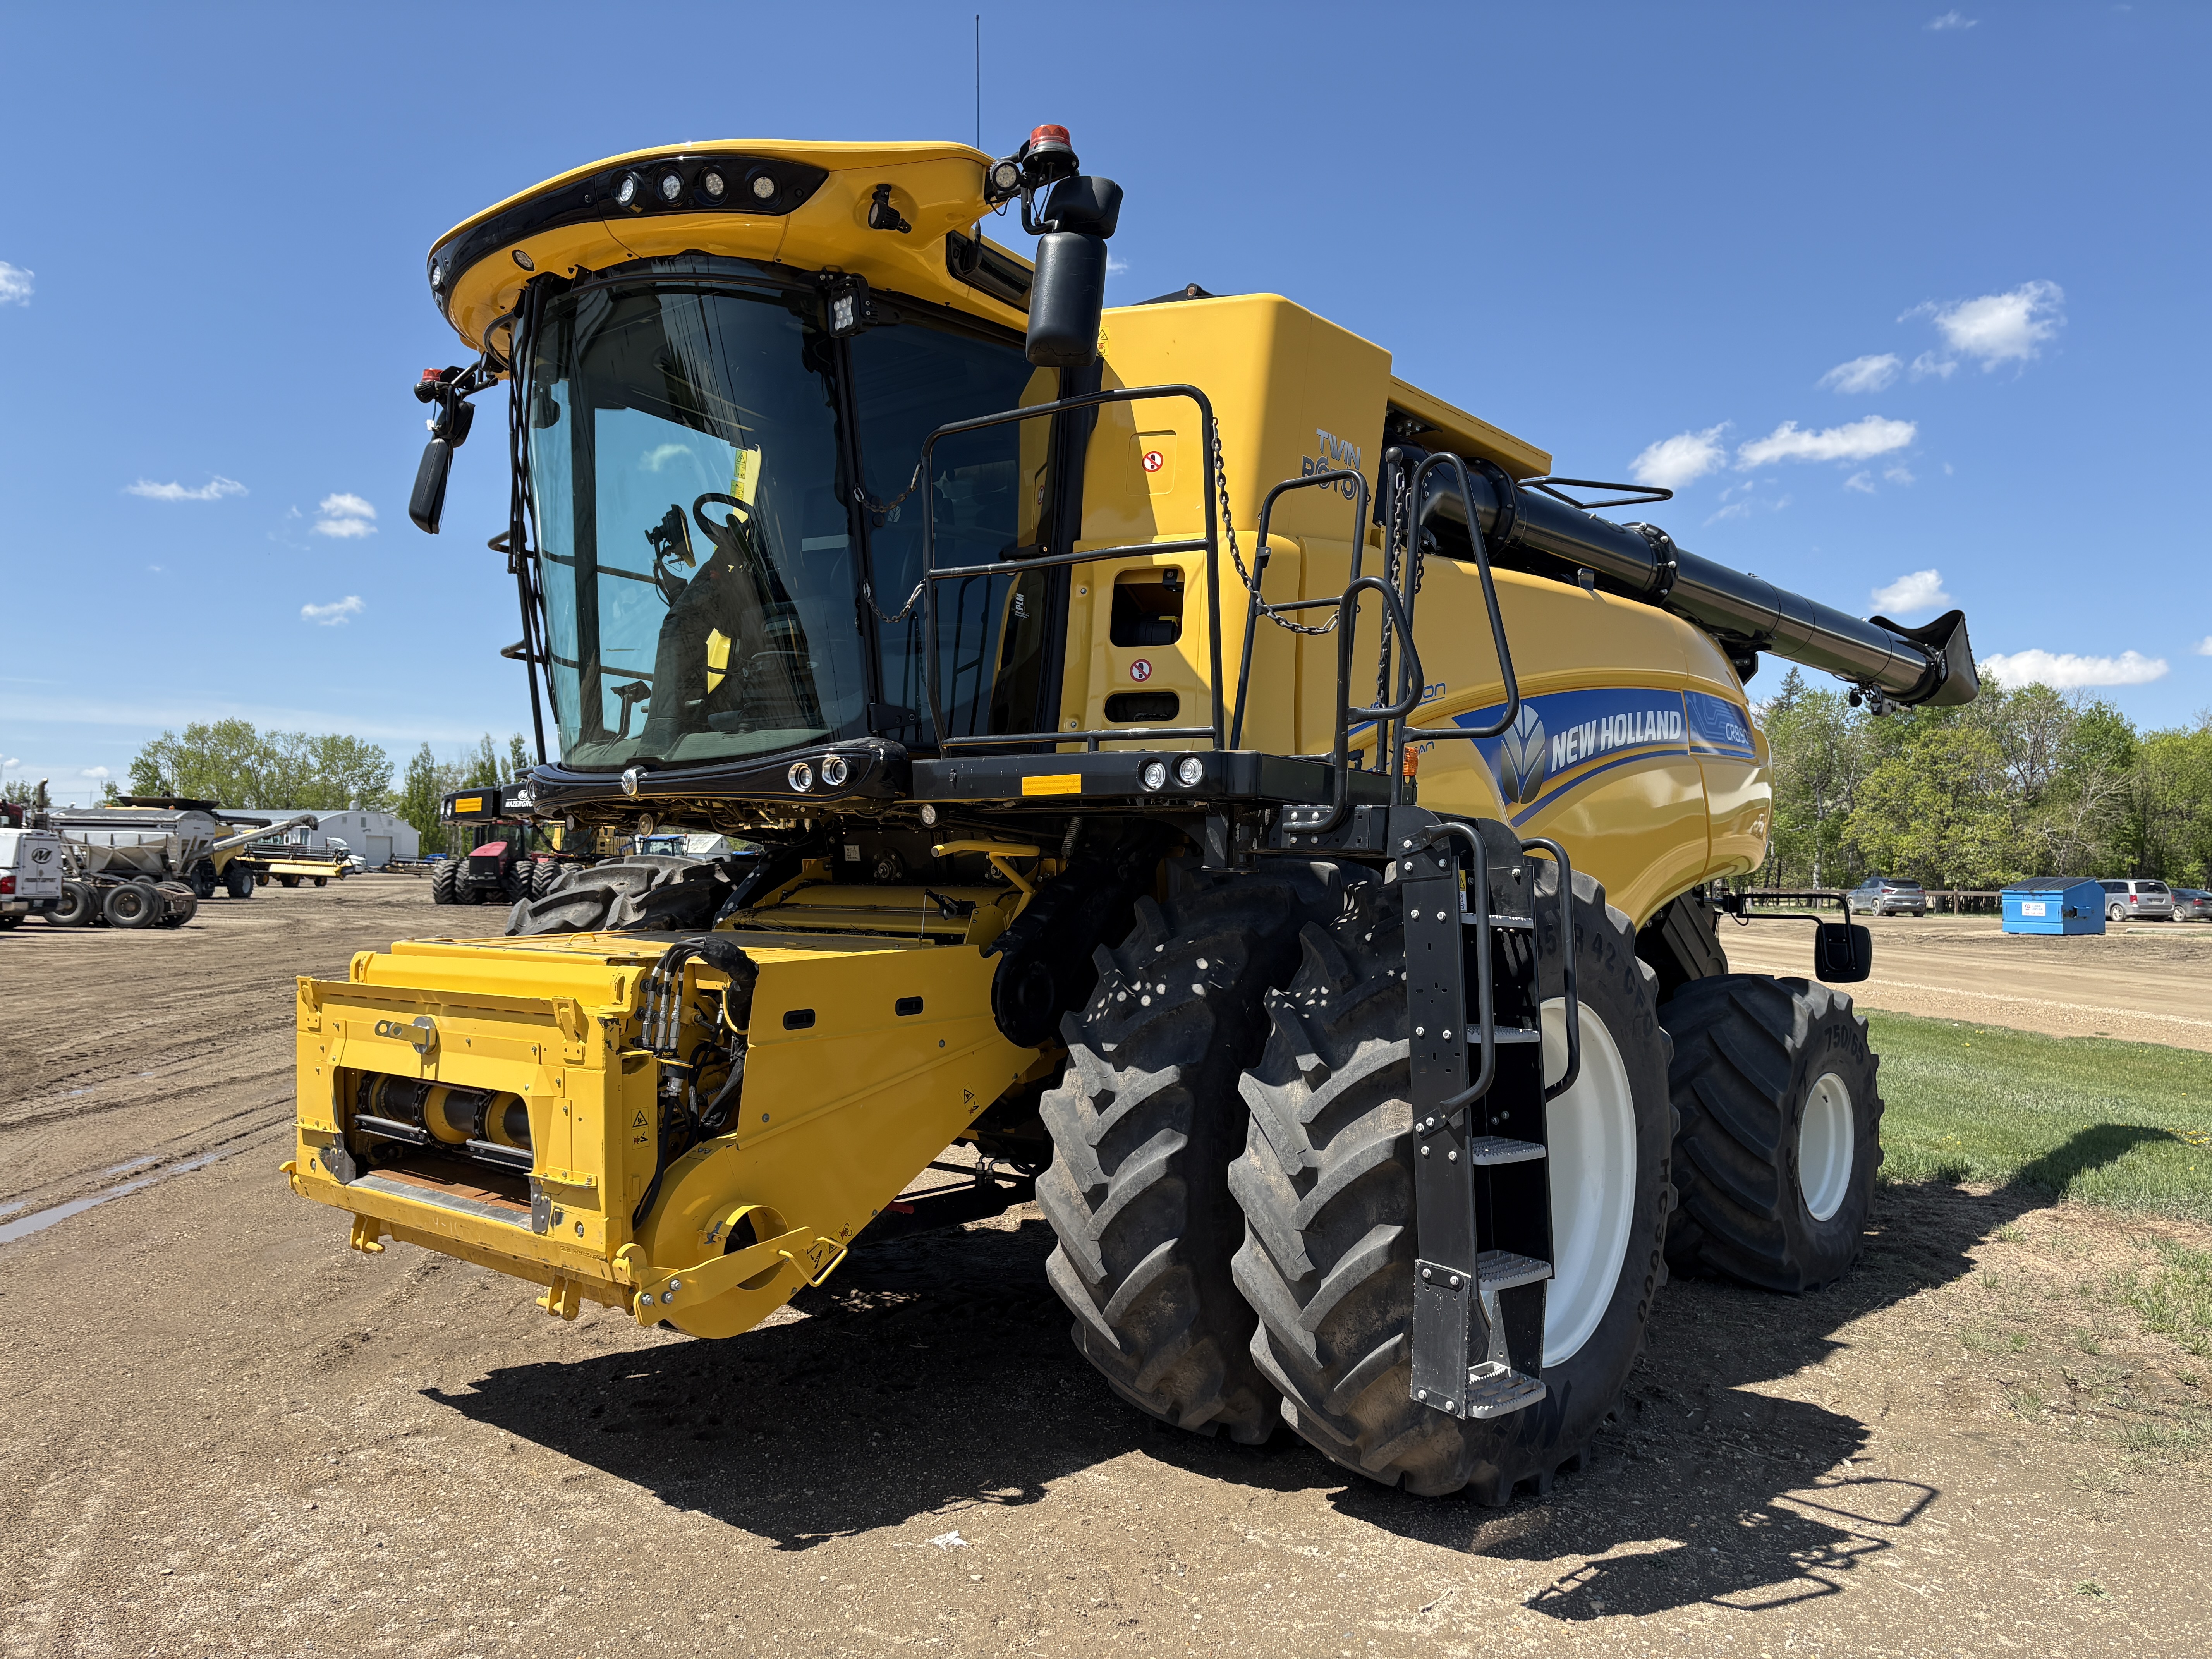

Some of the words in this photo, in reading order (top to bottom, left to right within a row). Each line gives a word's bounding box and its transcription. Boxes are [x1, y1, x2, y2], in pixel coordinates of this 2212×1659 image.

[1316, 428, 1361, 470] TWIN
[1302, 455, 1357, 500] ROTO
[1015, 593, 1024, 611] PLM
[1551, 720, 1597, 773] NEW
[1600, 711, 1681, 751] HOLLAND
[1824, 1025, 1864, 1064] 750/65
